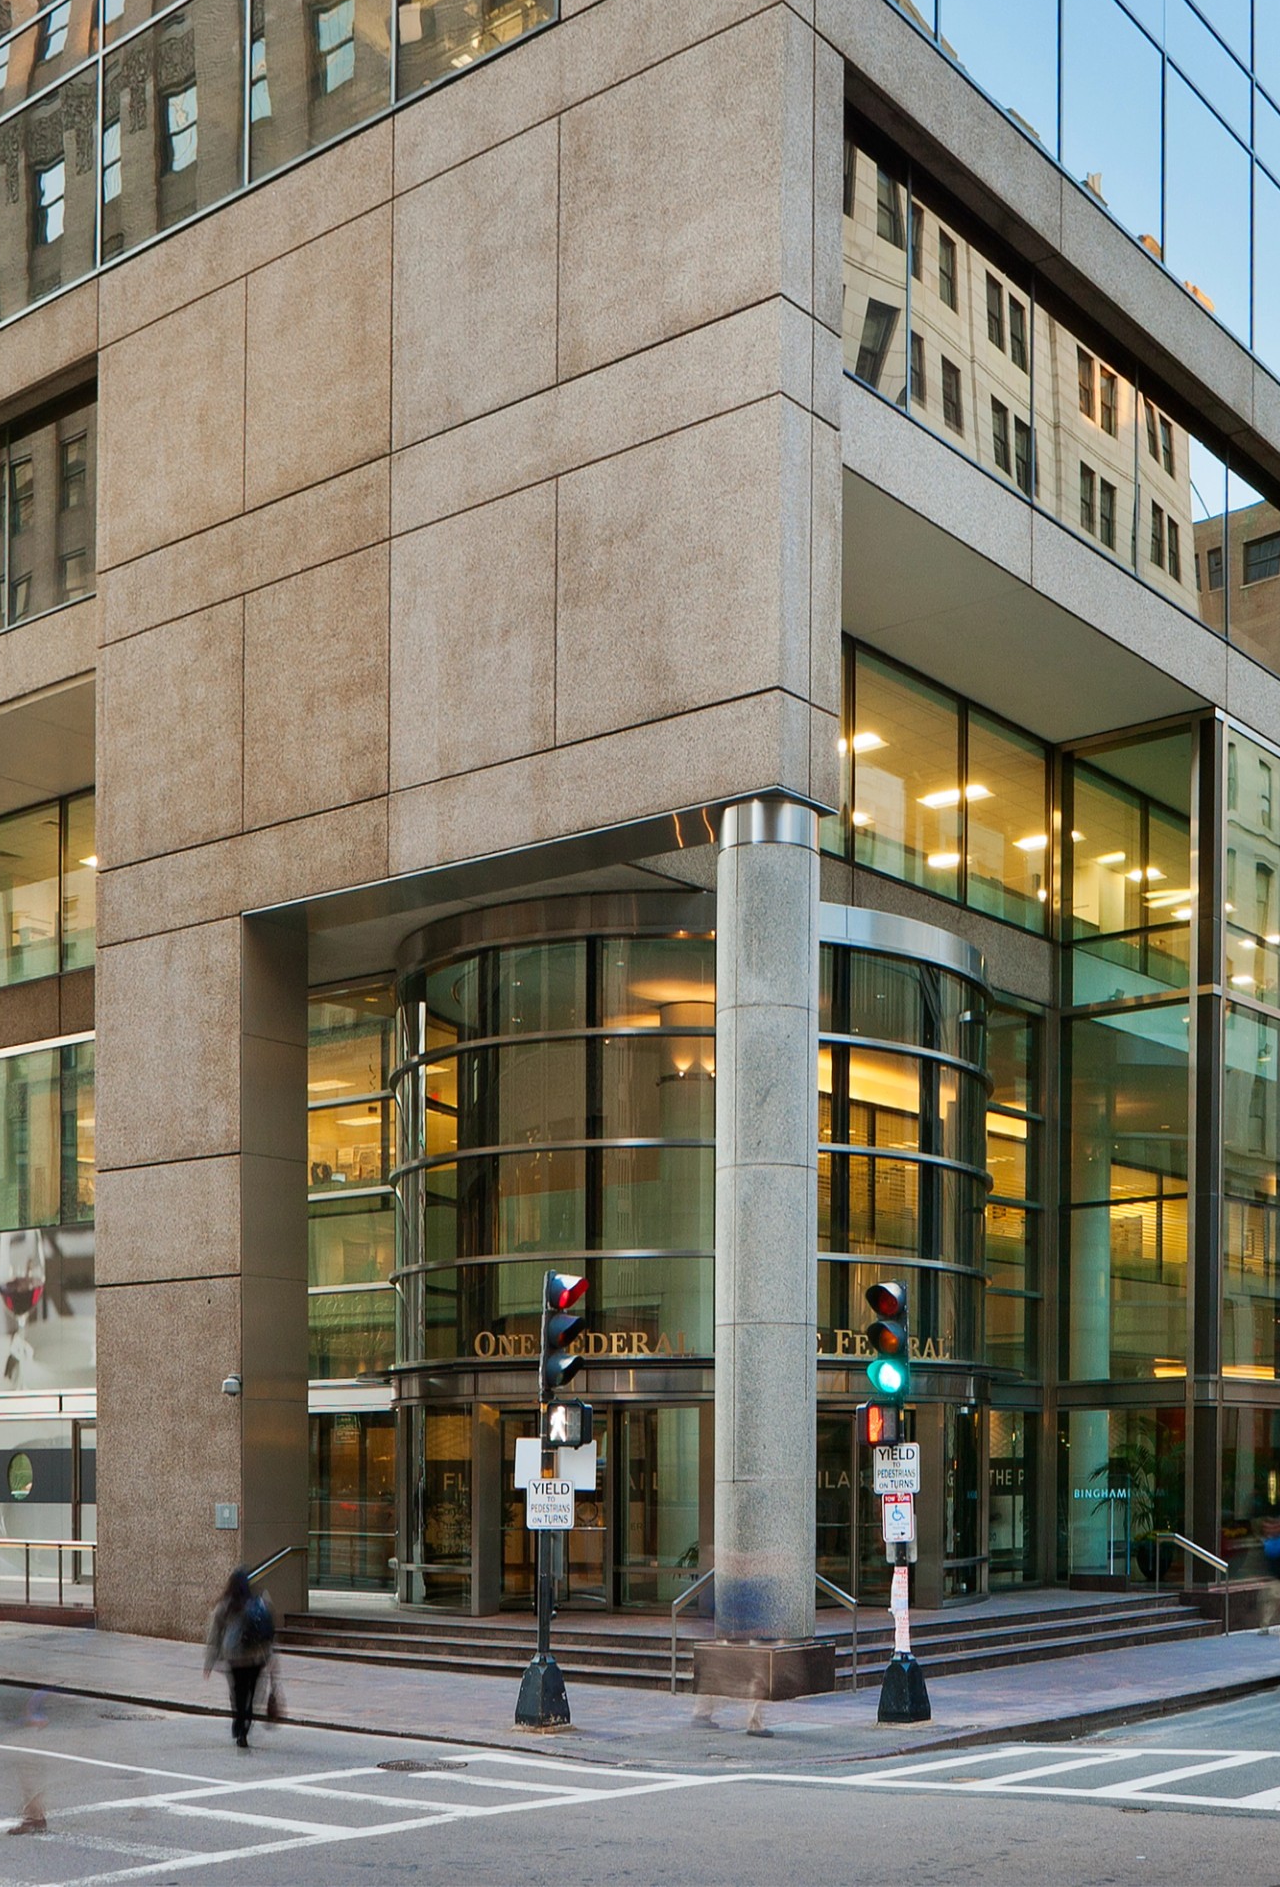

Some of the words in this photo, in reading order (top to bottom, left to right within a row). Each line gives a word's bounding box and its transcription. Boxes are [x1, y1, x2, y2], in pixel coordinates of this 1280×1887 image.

[474, 1331, 535, 1357] ONE
[566, 1330, 695, 1357] EDERAL
[834, 1329, 950, 1360] FERAL
[878, 1447, 916, 1461] YIELD
[877, 1469, 916, 1479] PEDESTRIANS
[532, 1482, 570, 1495] YIELD
[890, 1479, 914, 1489] TURNS
[531, 1503, 571, 1513] PEDESTRIANS
[544, 1514, 569, 1524] TURNS
